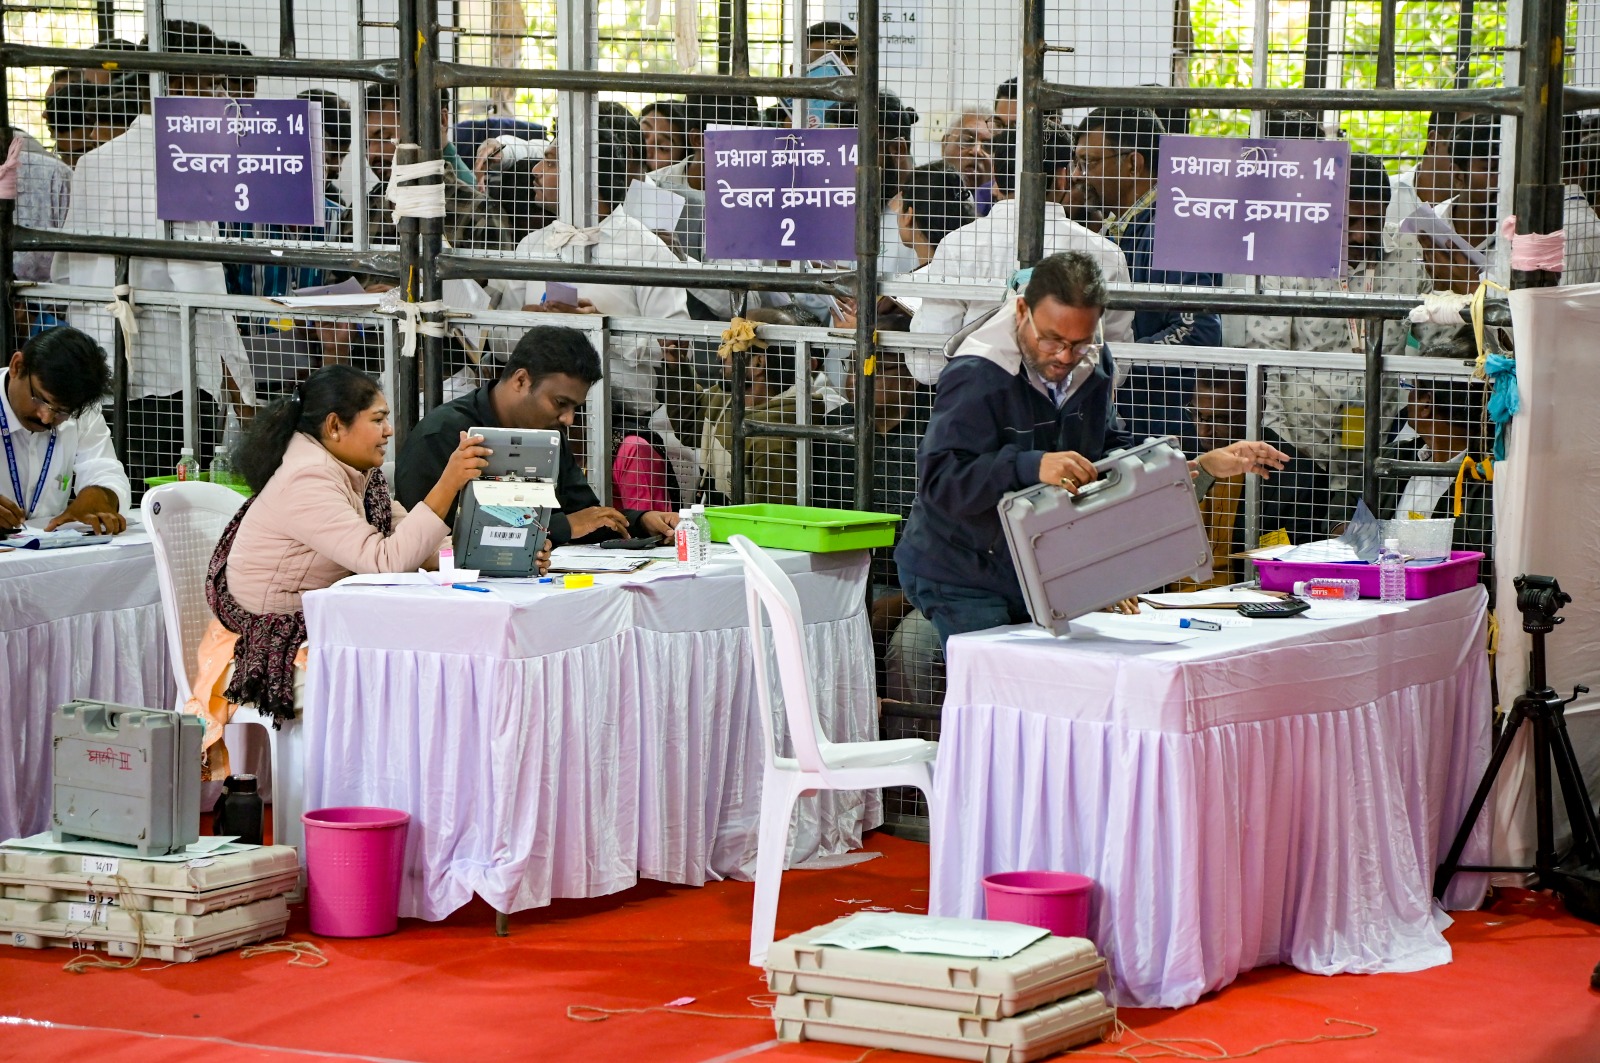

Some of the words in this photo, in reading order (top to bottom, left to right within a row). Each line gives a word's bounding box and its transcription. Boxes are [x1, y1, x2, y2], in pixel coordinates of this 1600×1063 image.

[903, 12, 915, 22] 14
[166, 115, 222, 133] प्रभाग
[286, 114, 304, 135] 14
[168, 144, 231, 173] टेबल
[236, 146, 304, 175] क्रमांक
[714, 149, 767, 167] प्रभाग
[837, 144, 858, 166] 14
[1170, 156, 1231, 176] प्रभाग
[1313, 157, 1336, 180] 14
[234, 183, 250, 211] 3
[716, 179, 775, 208] टेबल
[780, 178, 856, 209] क्रमांक
[1170, 187, 1238, 220] टेबल
[1244, 192, 1332, 224] क्रमांक
[780, 217, 796, 246] 2
[1242, 232, 1255, 261] 1
[95, 861, 113, 873] 14/17
[107, 896, 114, 905] 2
